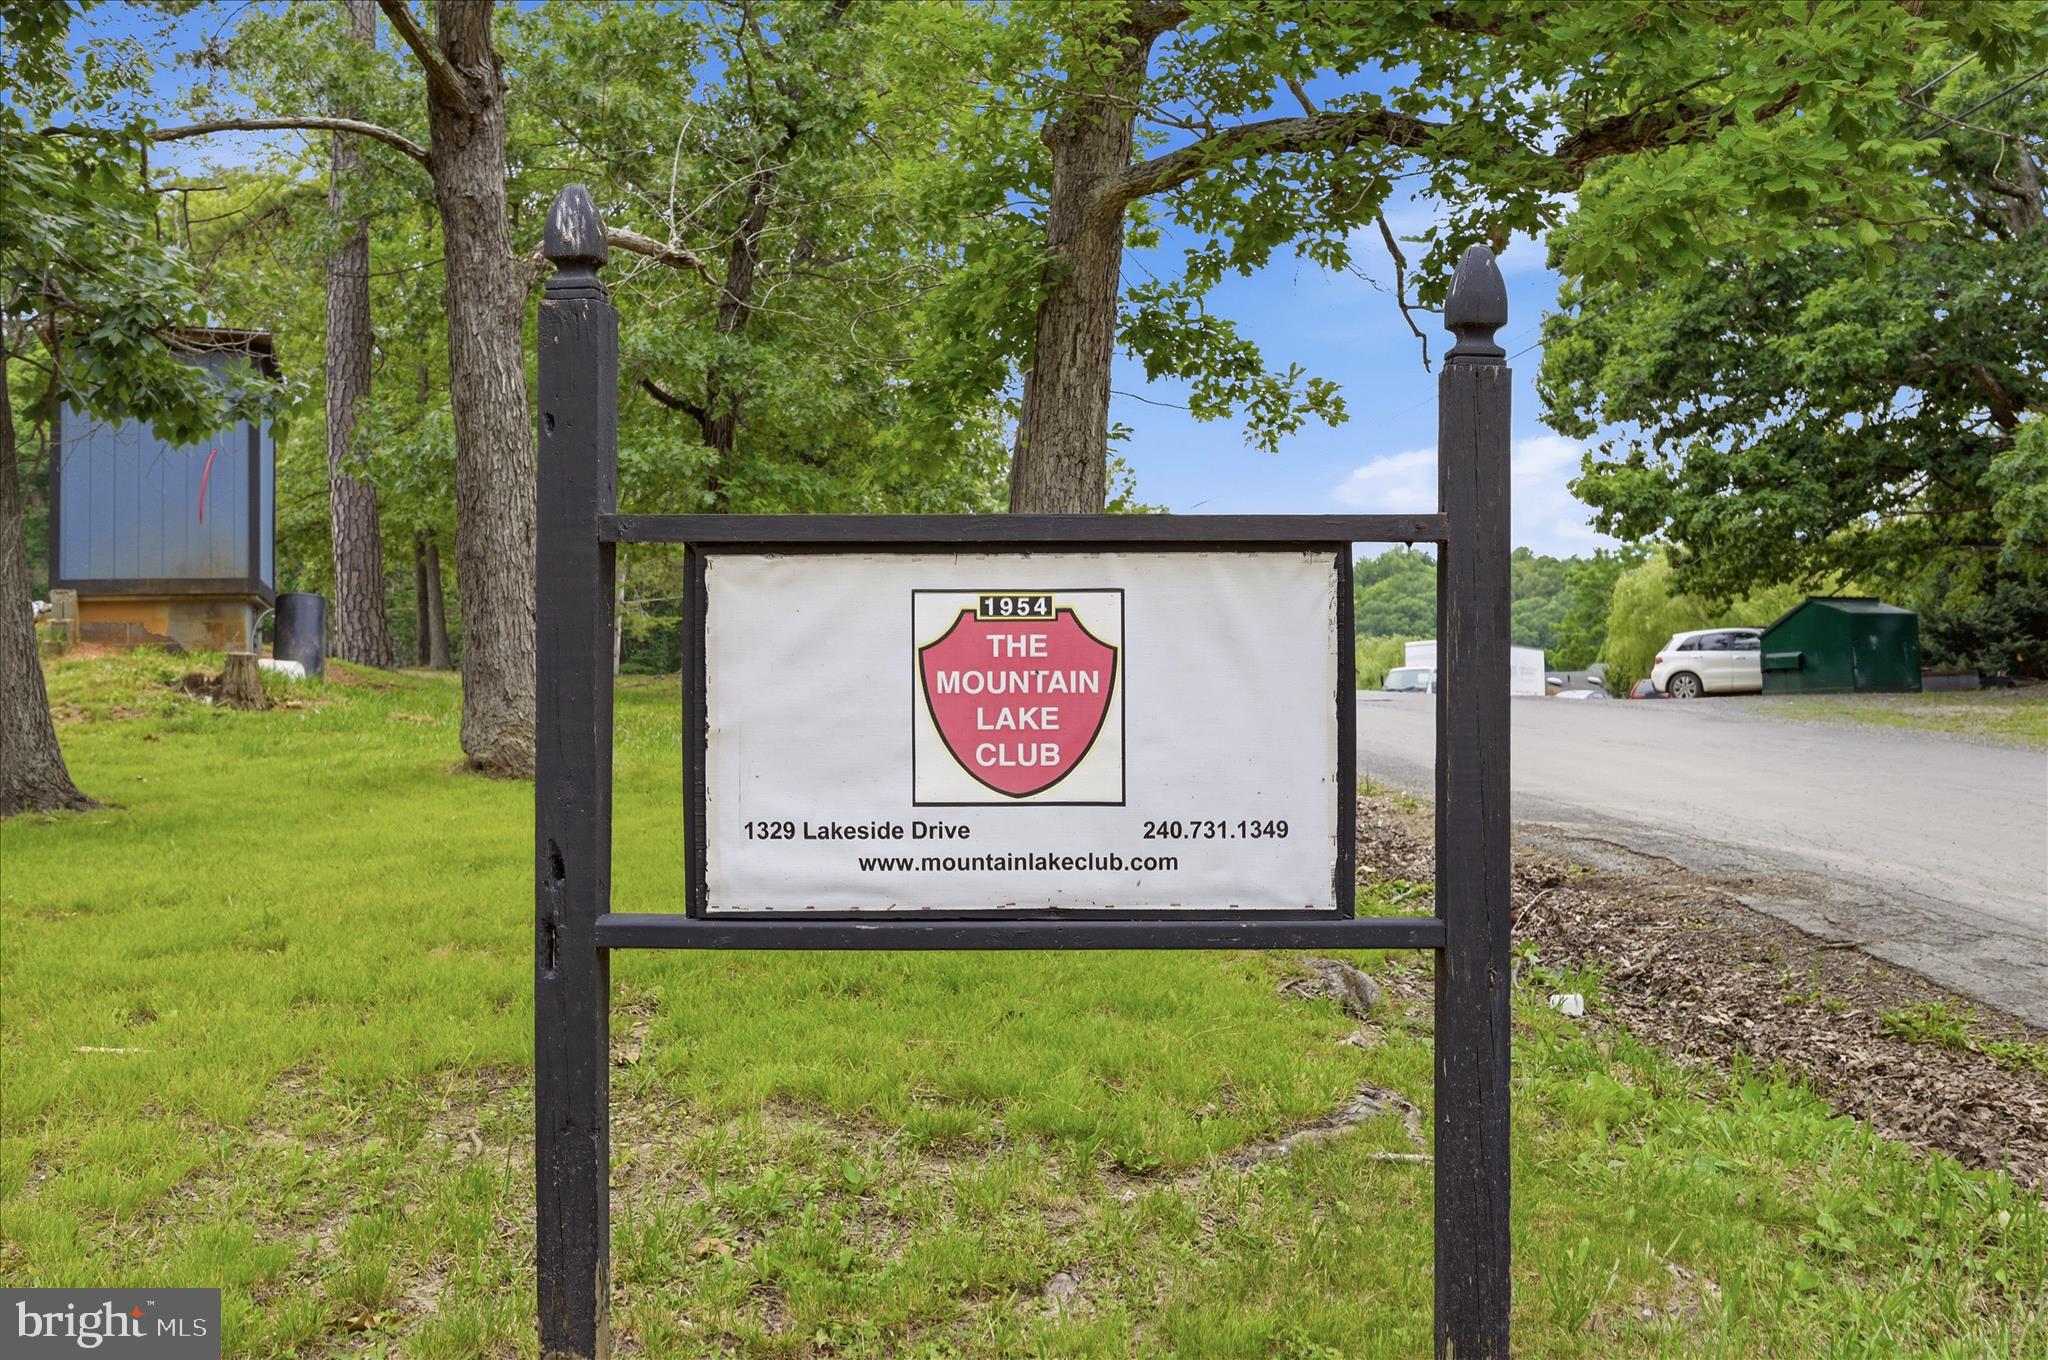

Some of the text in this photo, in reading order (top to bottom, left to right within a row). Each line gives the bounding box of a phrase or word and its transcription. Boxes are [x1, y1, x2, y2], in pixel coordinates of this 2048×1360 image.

[984, 597, 1048, 616] 1954
[986, 634, 1048, 658] THE
[937, 670, 1099, 694] MOUNTAIN
[976, 707, 1060, 731] LAKE
[975, 743, 1061, 768] CLUB
[743, 821, 971, 840] 1329 Lakeside Drive
[1143, 821, 1289, 839] 240.731.1349
[858, 852, 1179, 872] www.mountainlakeclub.com
